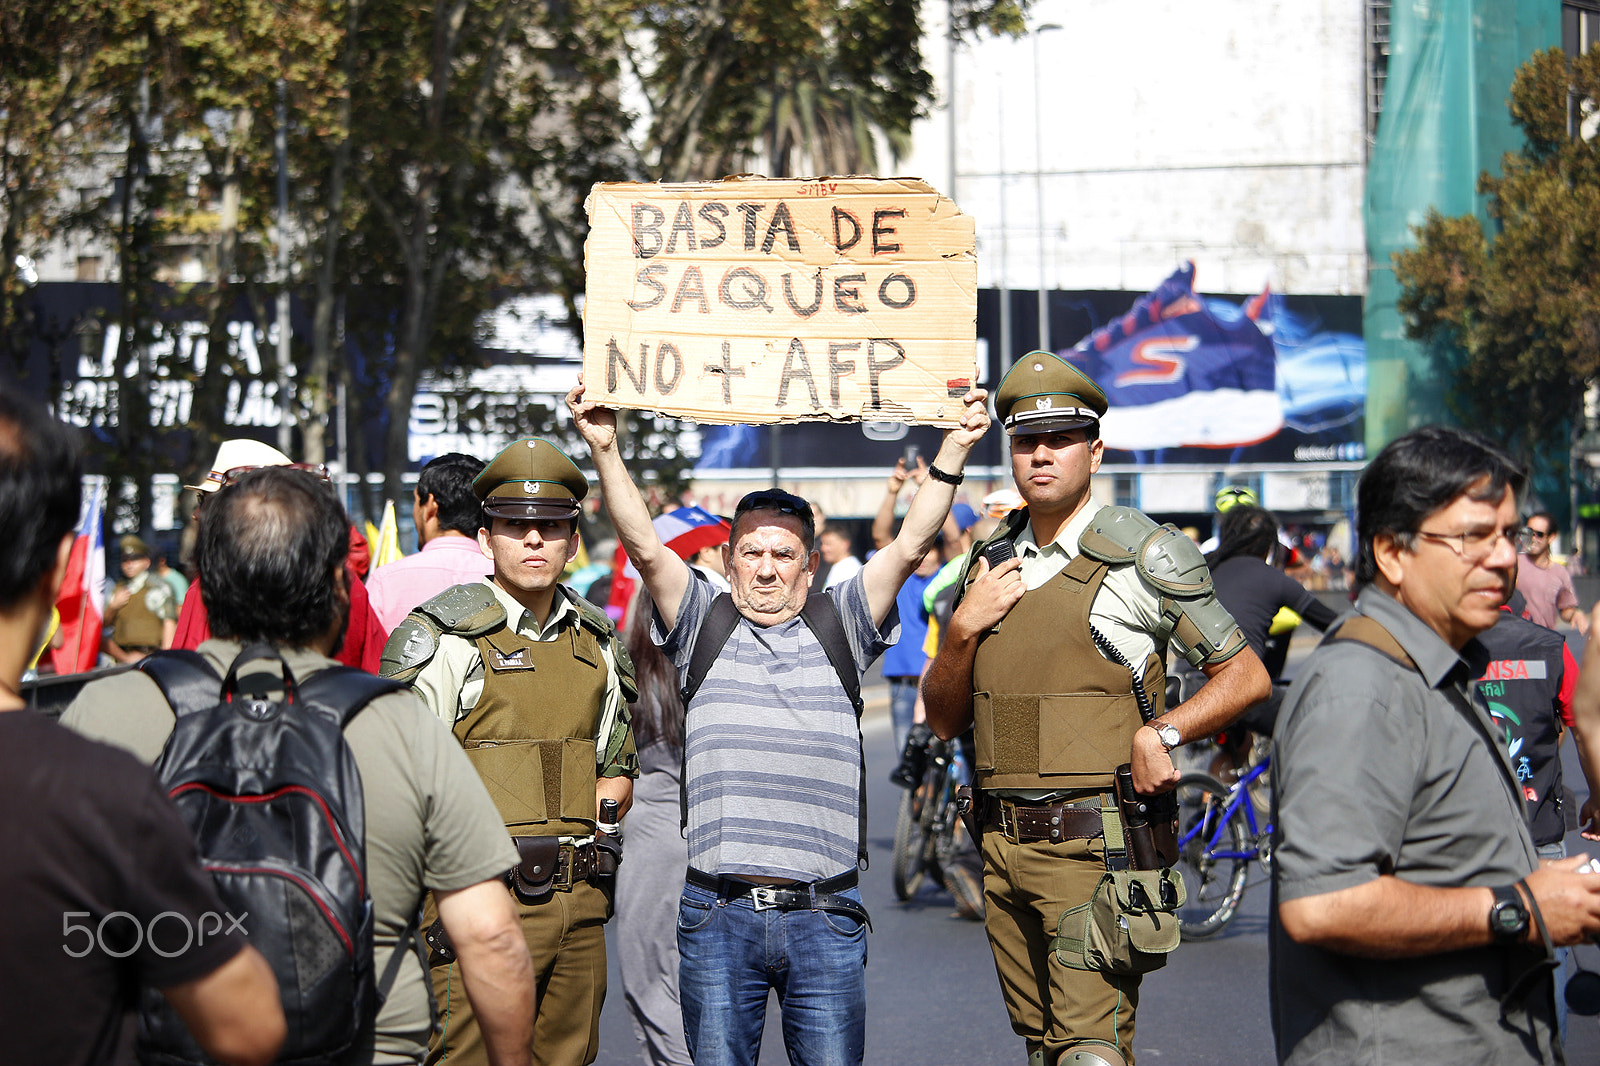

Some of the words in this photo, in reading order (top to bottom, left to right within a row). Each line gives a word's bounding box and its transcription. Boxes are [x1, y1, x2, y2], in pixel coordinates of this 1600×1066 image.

[630, 200, 801, 259] BASTA
[831, 204, 909, 257] DE
[625, 264, 918, 320] SAQUEO
[605, 336, 684, 397] NO
[775, 337, 906, 410] AFP
[1477, 659, 1529, 681] NSA
